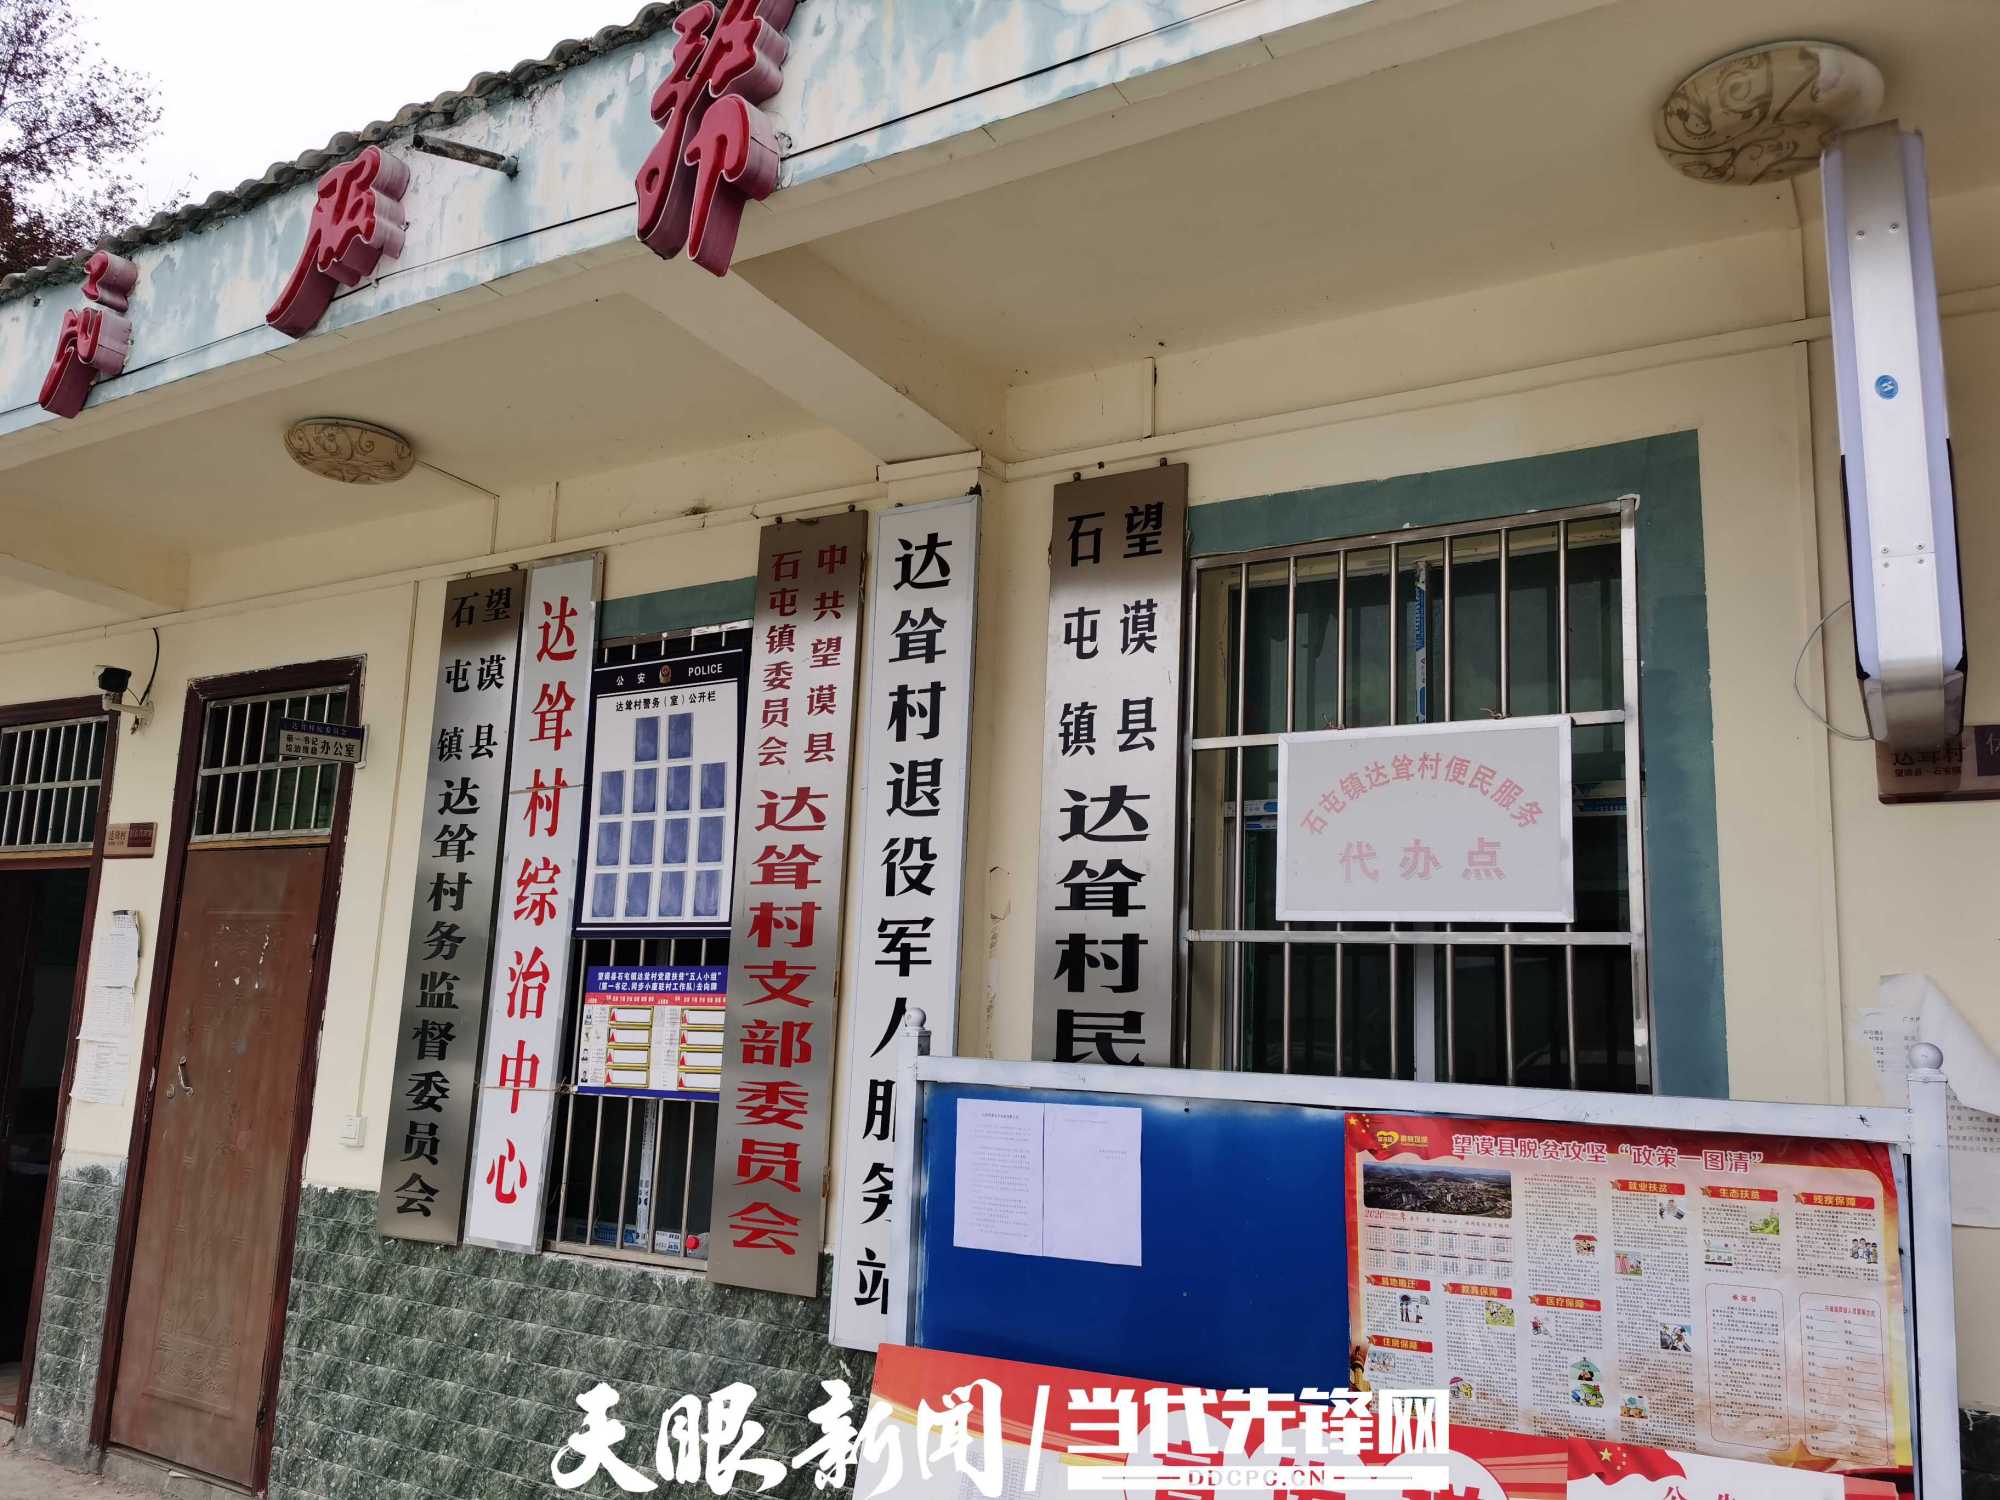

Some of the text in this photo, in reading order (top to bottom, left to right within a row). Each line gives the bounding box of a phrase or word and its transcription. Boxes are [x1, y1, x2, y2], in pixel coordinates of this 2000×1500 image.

[437, 592, 478, 762] 石屯镇
[469, 587, 512, 760] 望谟县
[616, 672, 646, 686] 公安
[688, 664, 723, 677] POLICE
[758, 550, 802, 766] 石屯镇委员会
[804, 544, 848, 763] 中共望谟县
[1058, 512, 1106, 757] 石屯镇
[1117, 501, 1164, 753] 望谟县
[321, 739, 356, 758] 办公室
[1300, 752, 1545, 836] 石屯镇达耷村便民服务
[486, 596, 578, 1205] 达耷村综治中心
[1053, 785, 1152, 1066] 达耷村民
[1338, 838, 1508, 881] 代办点
[394, 777, 480, 1218] 达耷村务监督委员会
[728, 786, 829, 1256] 达耷村支部委员会
[1719, 1187, 1761, 1201] 生态扶贫
[1812, 1194, 1857, 1208] 残疾保障
[1546, 1296, 1585, 1310] 医疗保障
